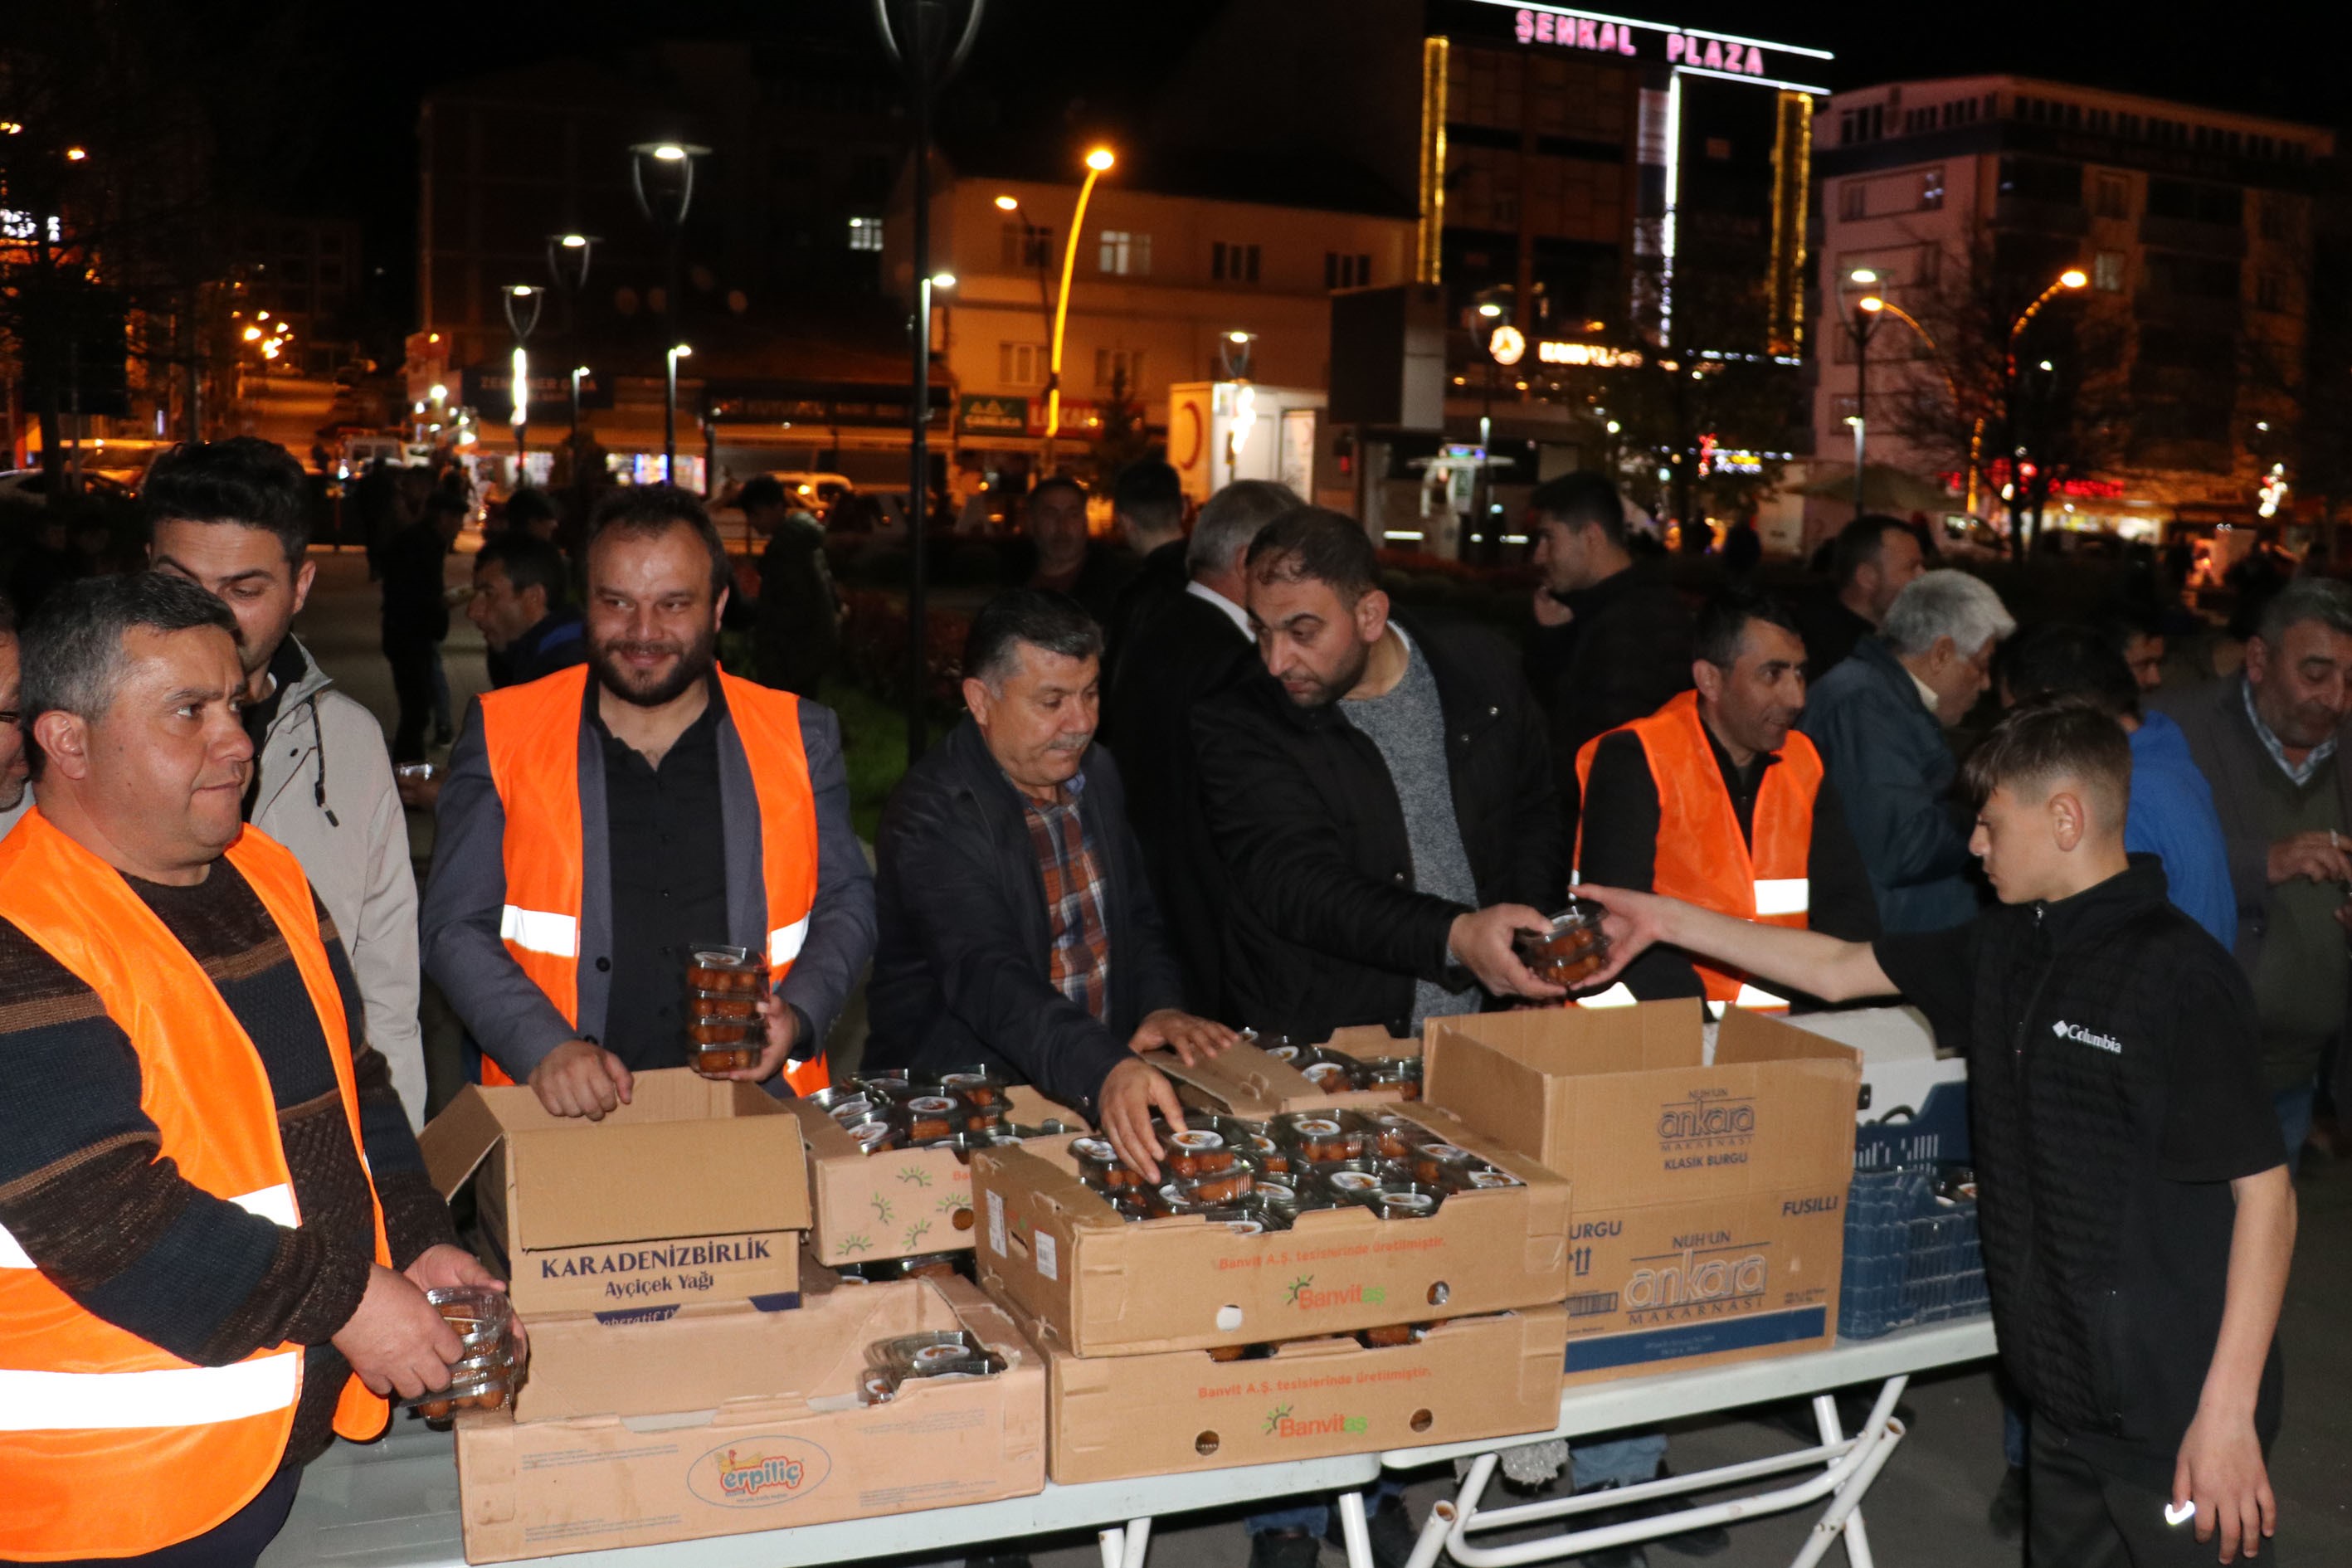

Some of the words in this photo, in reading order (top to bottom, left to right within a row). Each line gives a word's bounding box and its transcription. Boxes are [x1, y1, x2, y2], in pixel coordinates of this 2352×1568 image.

[1515, 9, 1636, 56] ŞENKAL
[1666, 33, 1764, 76] PLAZA
[1658, 1098, 1755, 1138] ankara
[1707, 1152, 1747, 1166] BURGU
[1782, 1195, 1839, 1217] FUSILLI
[542, 1237, 771, 1279] KARADENİZBİRLİK
[605, 1276, 672, 1298] Ayçiçek
[679, 1271, 713, 1291] Yağı
[1624, 1249, 1767, 1308] ankara
[1629, 1296, 1763, 1325] MAKARNASI
[1198, 1384, 1242, 1400] Banvit
[723, 1460, 800, 1491] erpiliç
